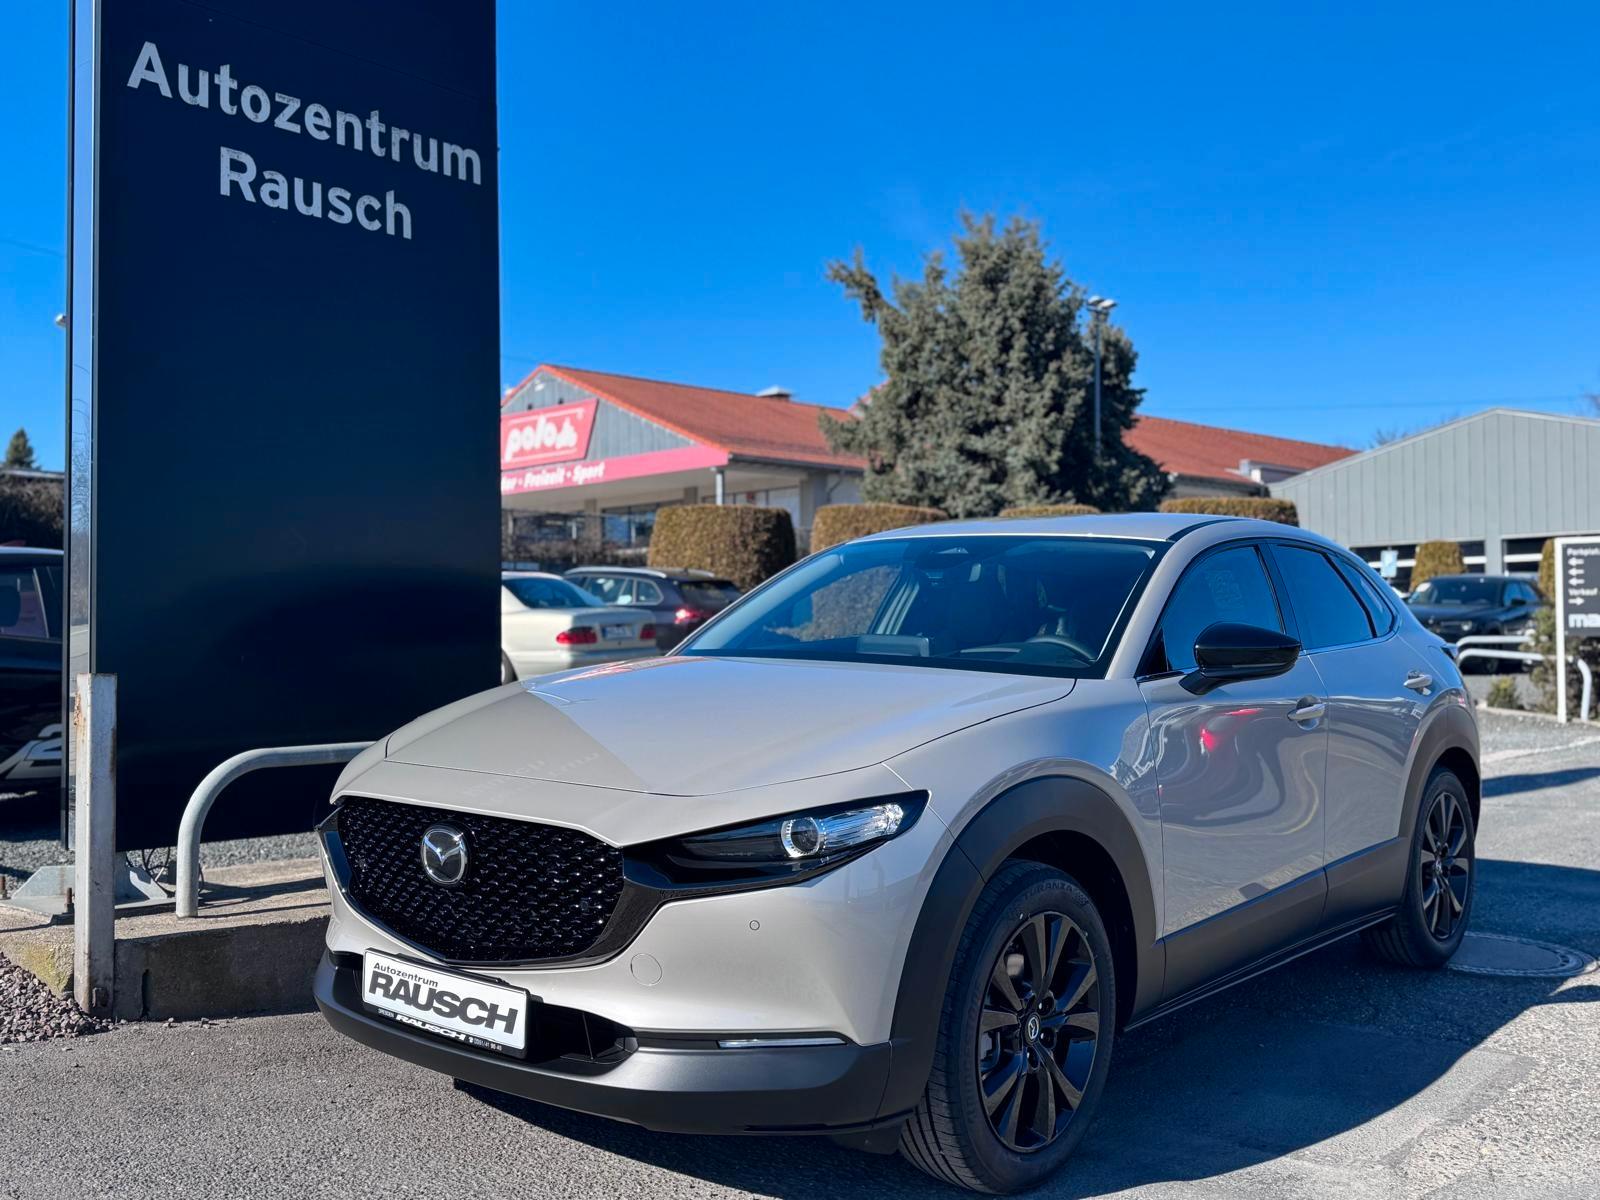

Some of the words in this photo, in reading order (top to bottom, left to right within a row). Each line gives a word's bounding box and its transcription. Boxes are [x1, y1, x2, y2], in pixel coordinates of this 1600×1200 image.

[126, 41, 482, 185] Autozentrum
[219, 146, 412, 240] Rausch
[572, 461, 606, 485] Sport
[373, 962, 439, 988] Autozentrum
[368, 970, 519, 1035] RAUSCH
[396, 1014, 467, 1041] RAUSCH
